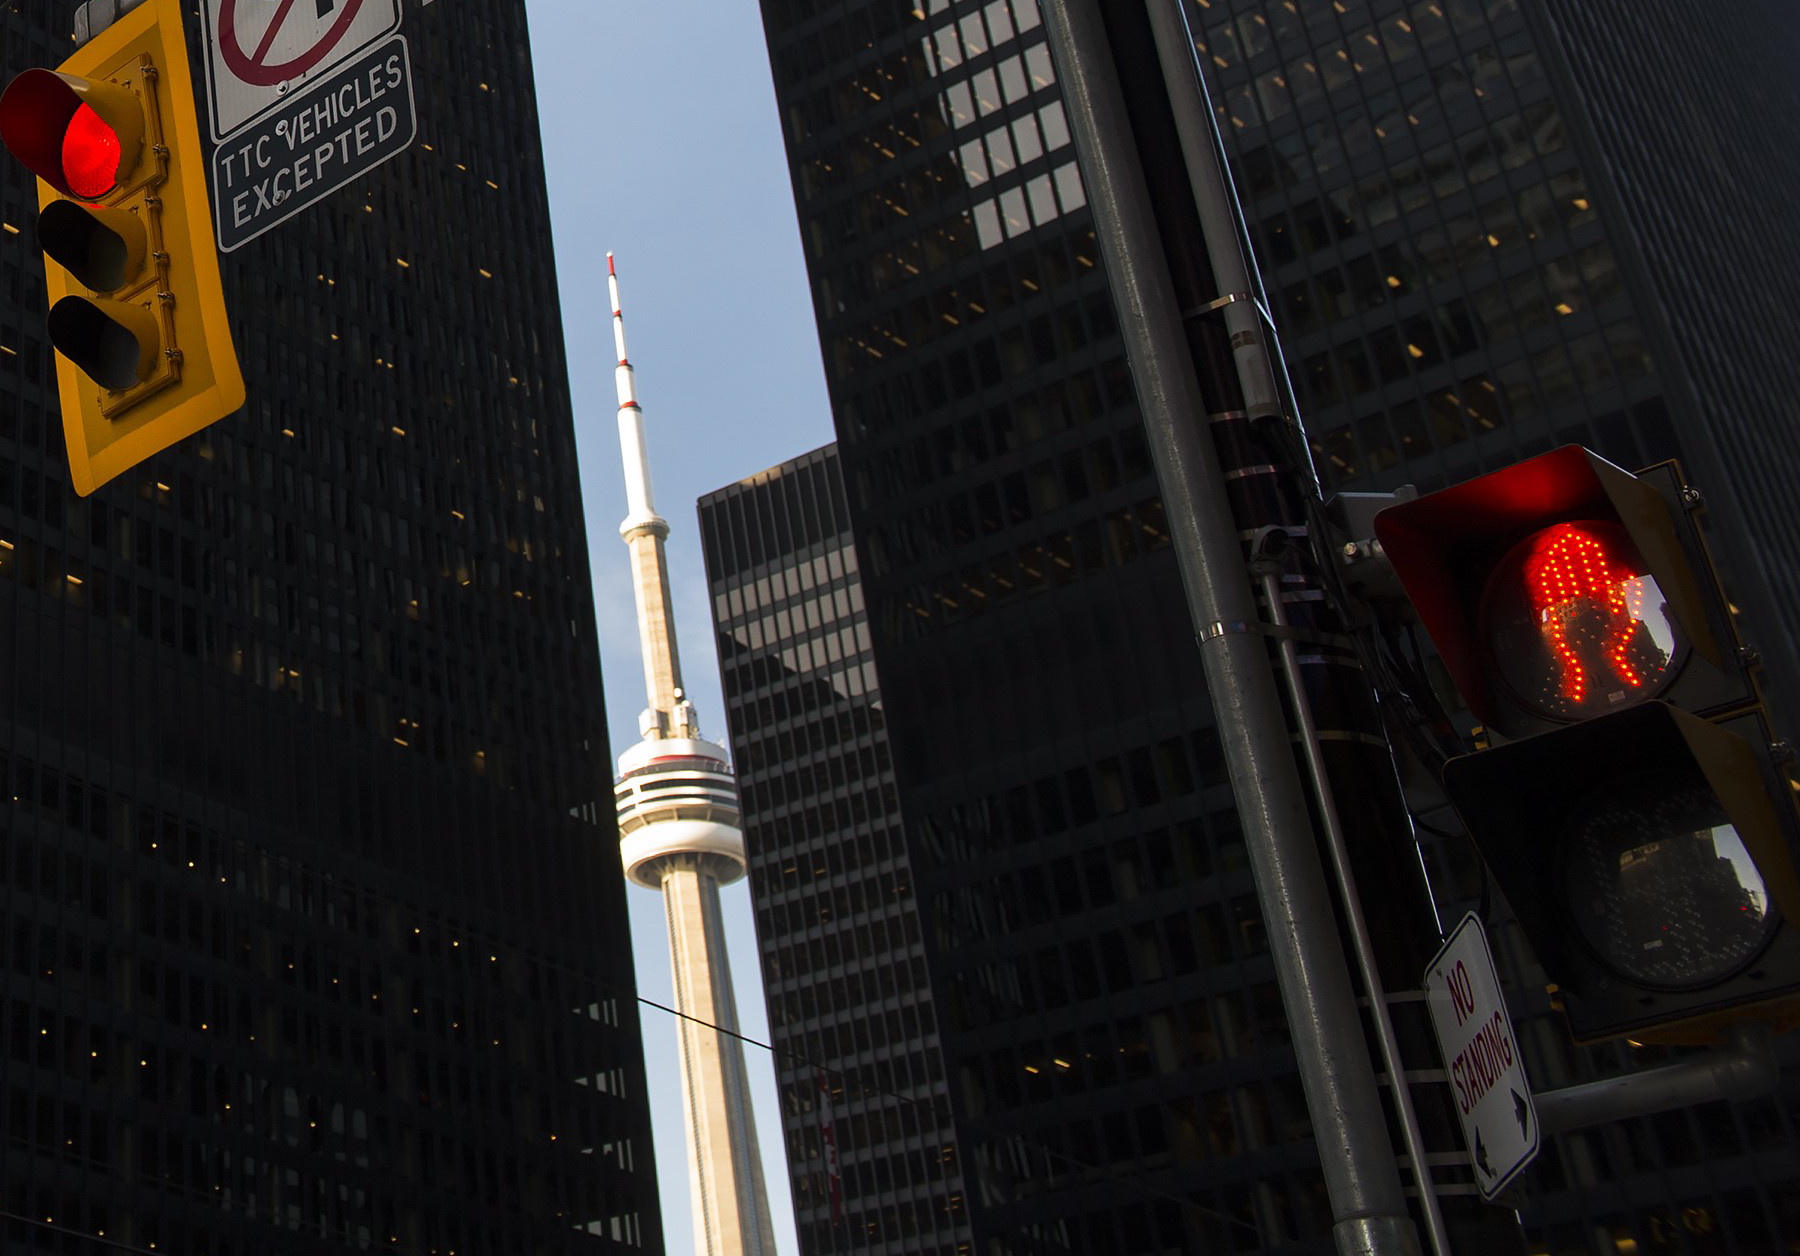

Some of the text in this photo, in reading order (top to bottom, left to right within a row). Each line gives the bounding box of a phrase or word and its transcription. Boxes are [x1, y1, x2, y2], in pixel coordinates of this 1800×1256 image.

[220, 54, 402, 188] TTC VEHICLES
[232, 105, 398, 229] EXCEPTED
[1446, 959, 1475, 1027] NO
[1452, 1010, 1513, 1115] STANDING
